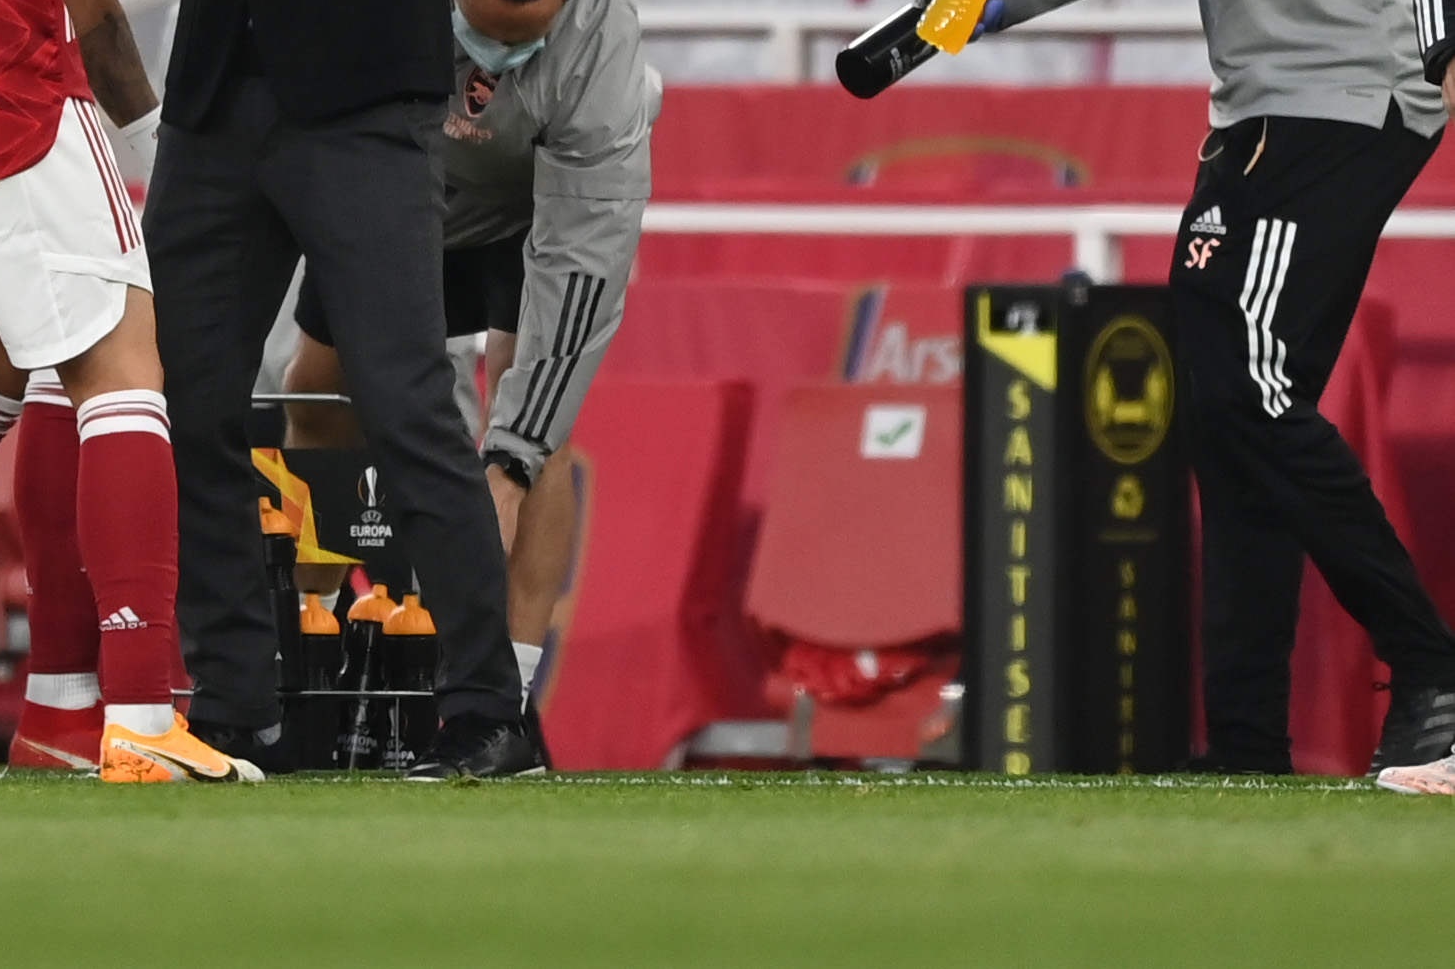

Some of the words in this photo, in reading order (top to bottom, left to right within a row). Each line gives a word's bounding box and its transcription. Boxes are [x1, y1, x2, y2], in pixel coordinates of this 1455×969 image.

[1189, 222, 1227, 235] adidas
[1184, 236, 1221, 270] SF
[350, 525, 393, 537] EUROPA
[357, 539, 386, 547] LEAGUE
